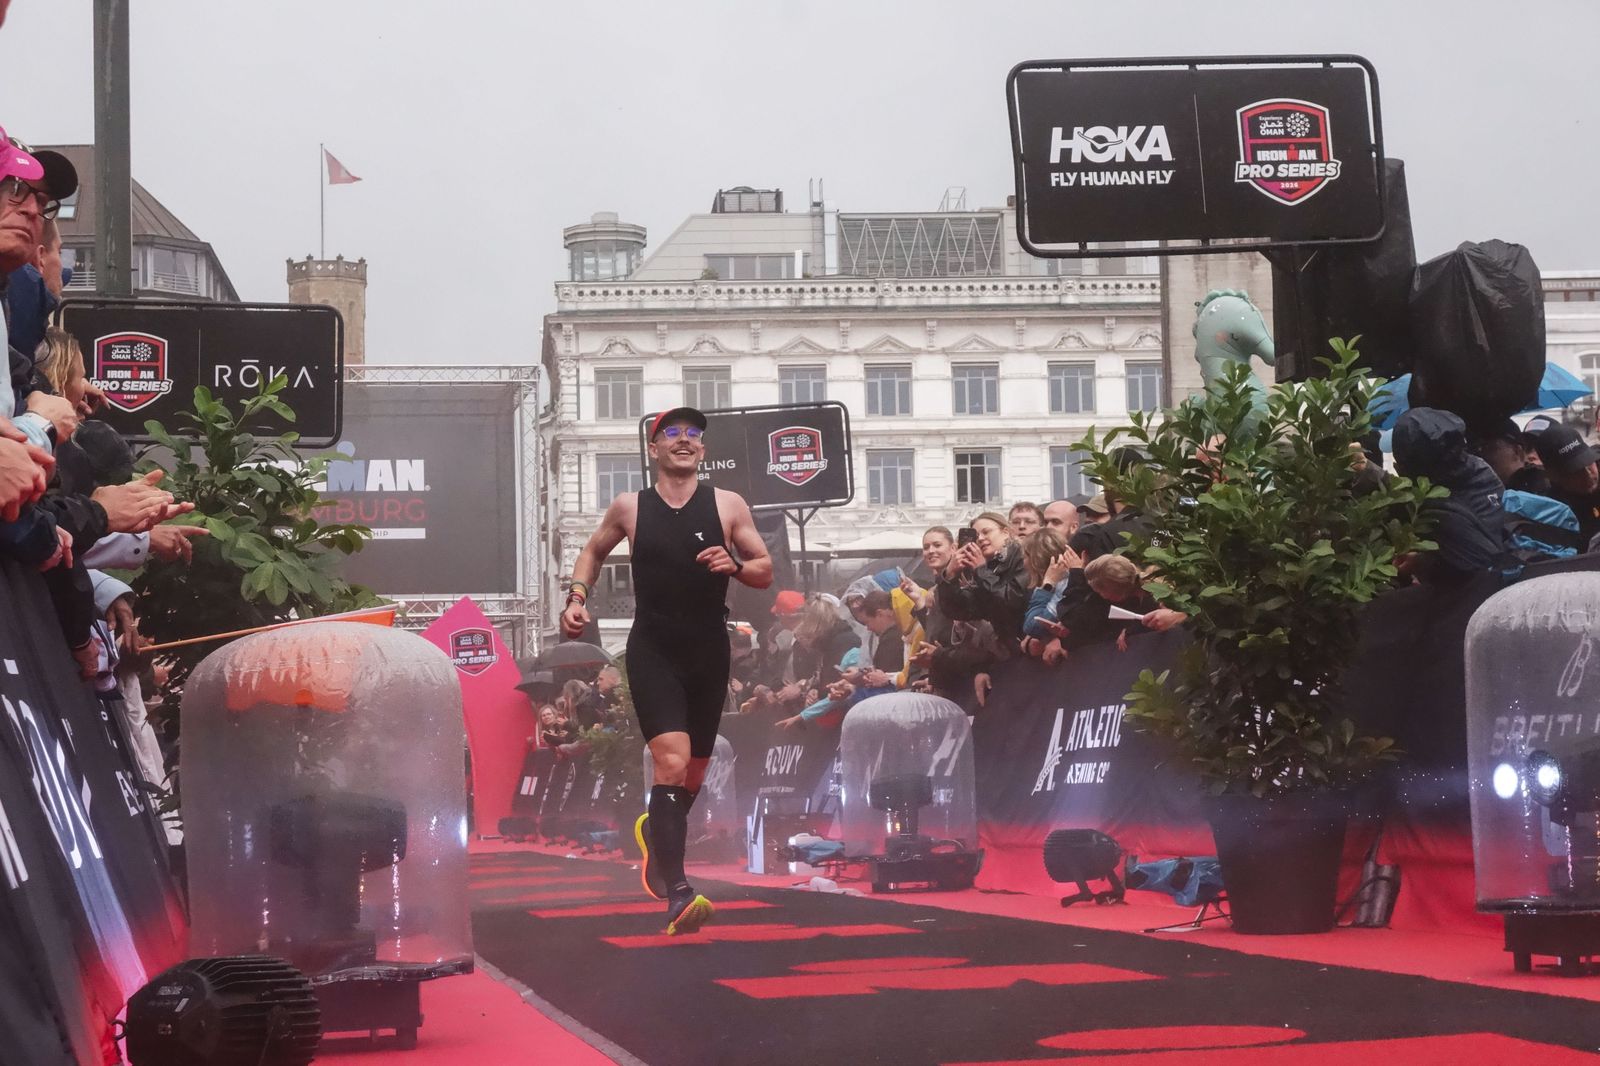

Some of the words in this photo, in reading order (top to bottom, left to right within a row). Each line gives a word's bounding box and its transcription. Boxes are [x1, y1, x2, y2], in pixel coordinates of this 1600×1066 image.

[1050, 126, 1173, 163] HOKA
[1051, 172, 1077, 186] FLY
[1080, 170, 1145, 186] HUMAN
[1147, 170, 1174, 184] FLY
[1239, 164, 1275, 178] PRO
[1277, 163, 1337, 177] SERIES
[121, 380, 170, 391] SERIES
[770, 463, 790, 472] PRO
[791, 460, 825, 471] SERIES
